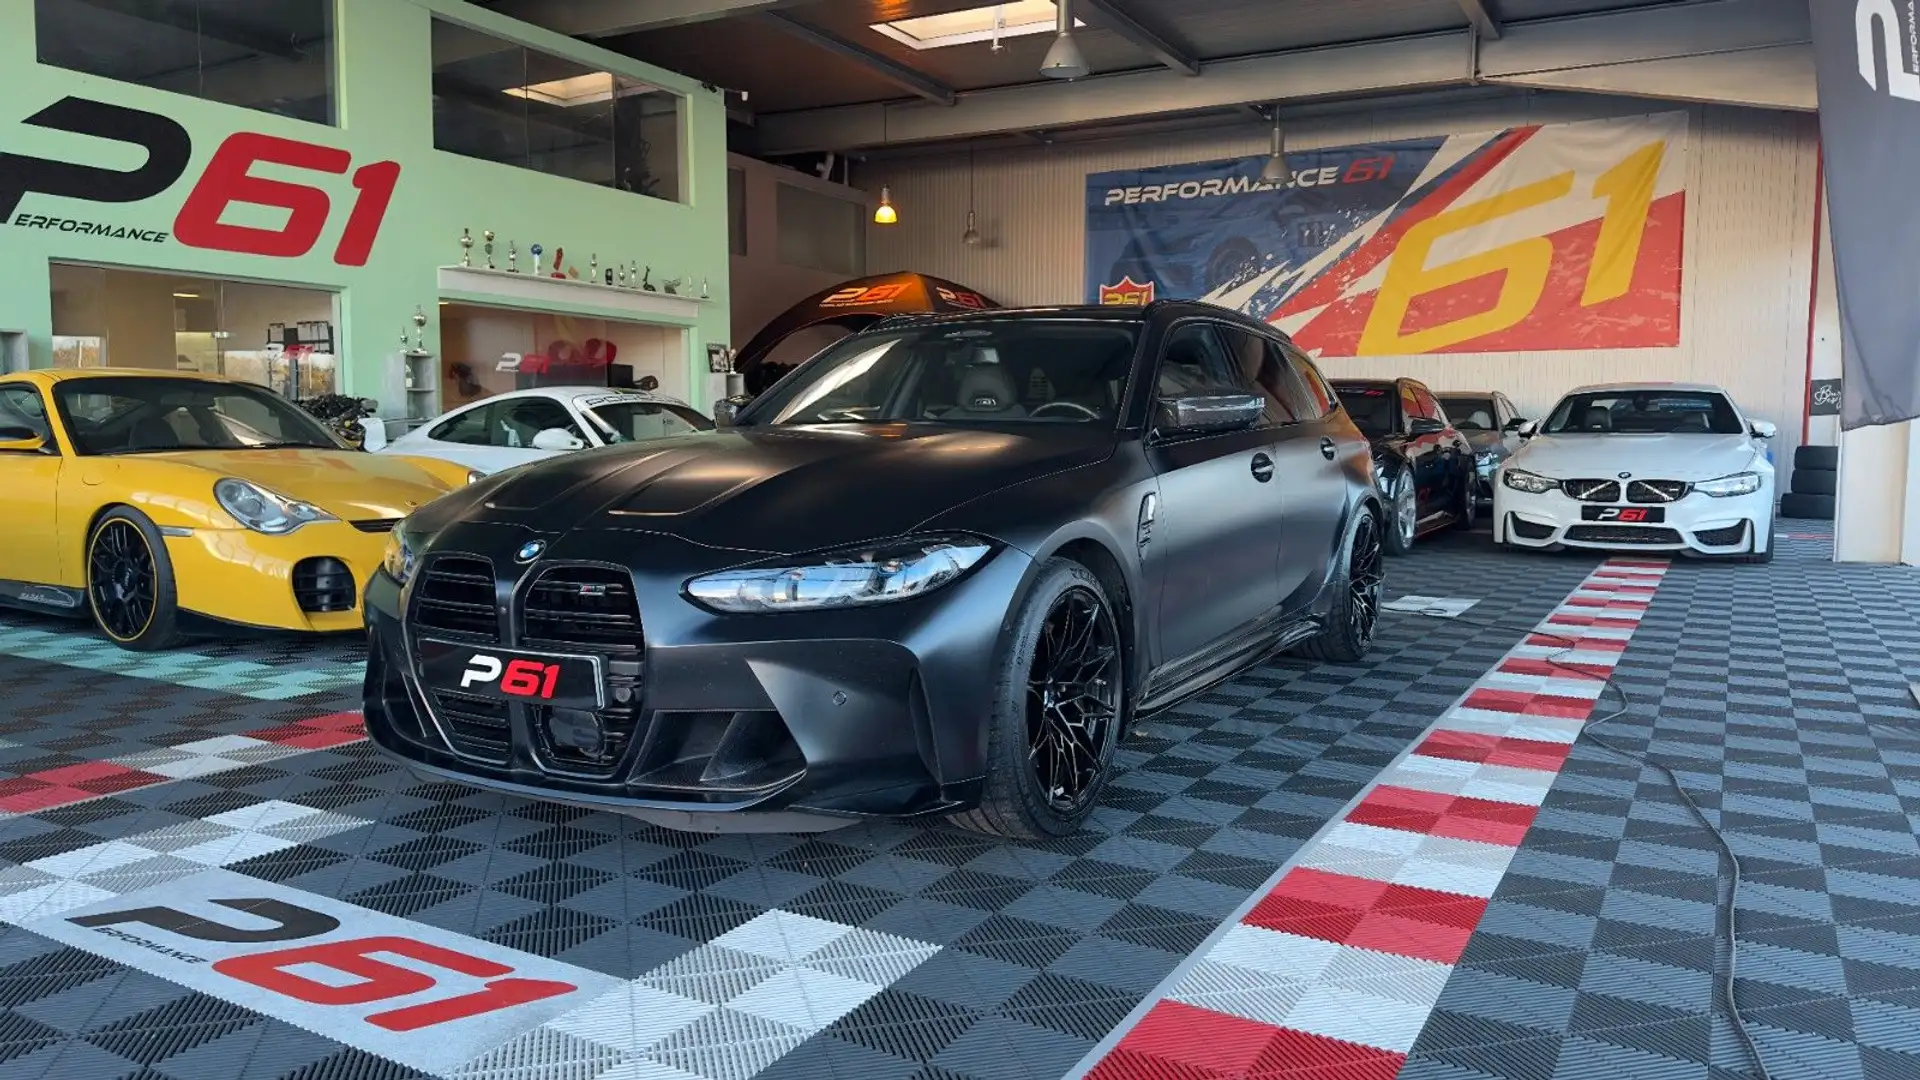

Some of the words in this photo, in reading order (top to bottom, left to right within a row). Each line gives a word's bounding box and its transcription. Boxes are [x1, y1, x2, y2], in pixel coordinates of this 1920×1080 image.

[0, 95, 401, 267] P61
[1342, 155, 1396, 183] 61
[14, 213, 169, 243] ERFORMANCE
[1356, 139, 1667, 356] 61
[1598, 508, 1648, 522] P61
[460, 654, 560, 699] P61
[65, 898, 578, 1032] P61
